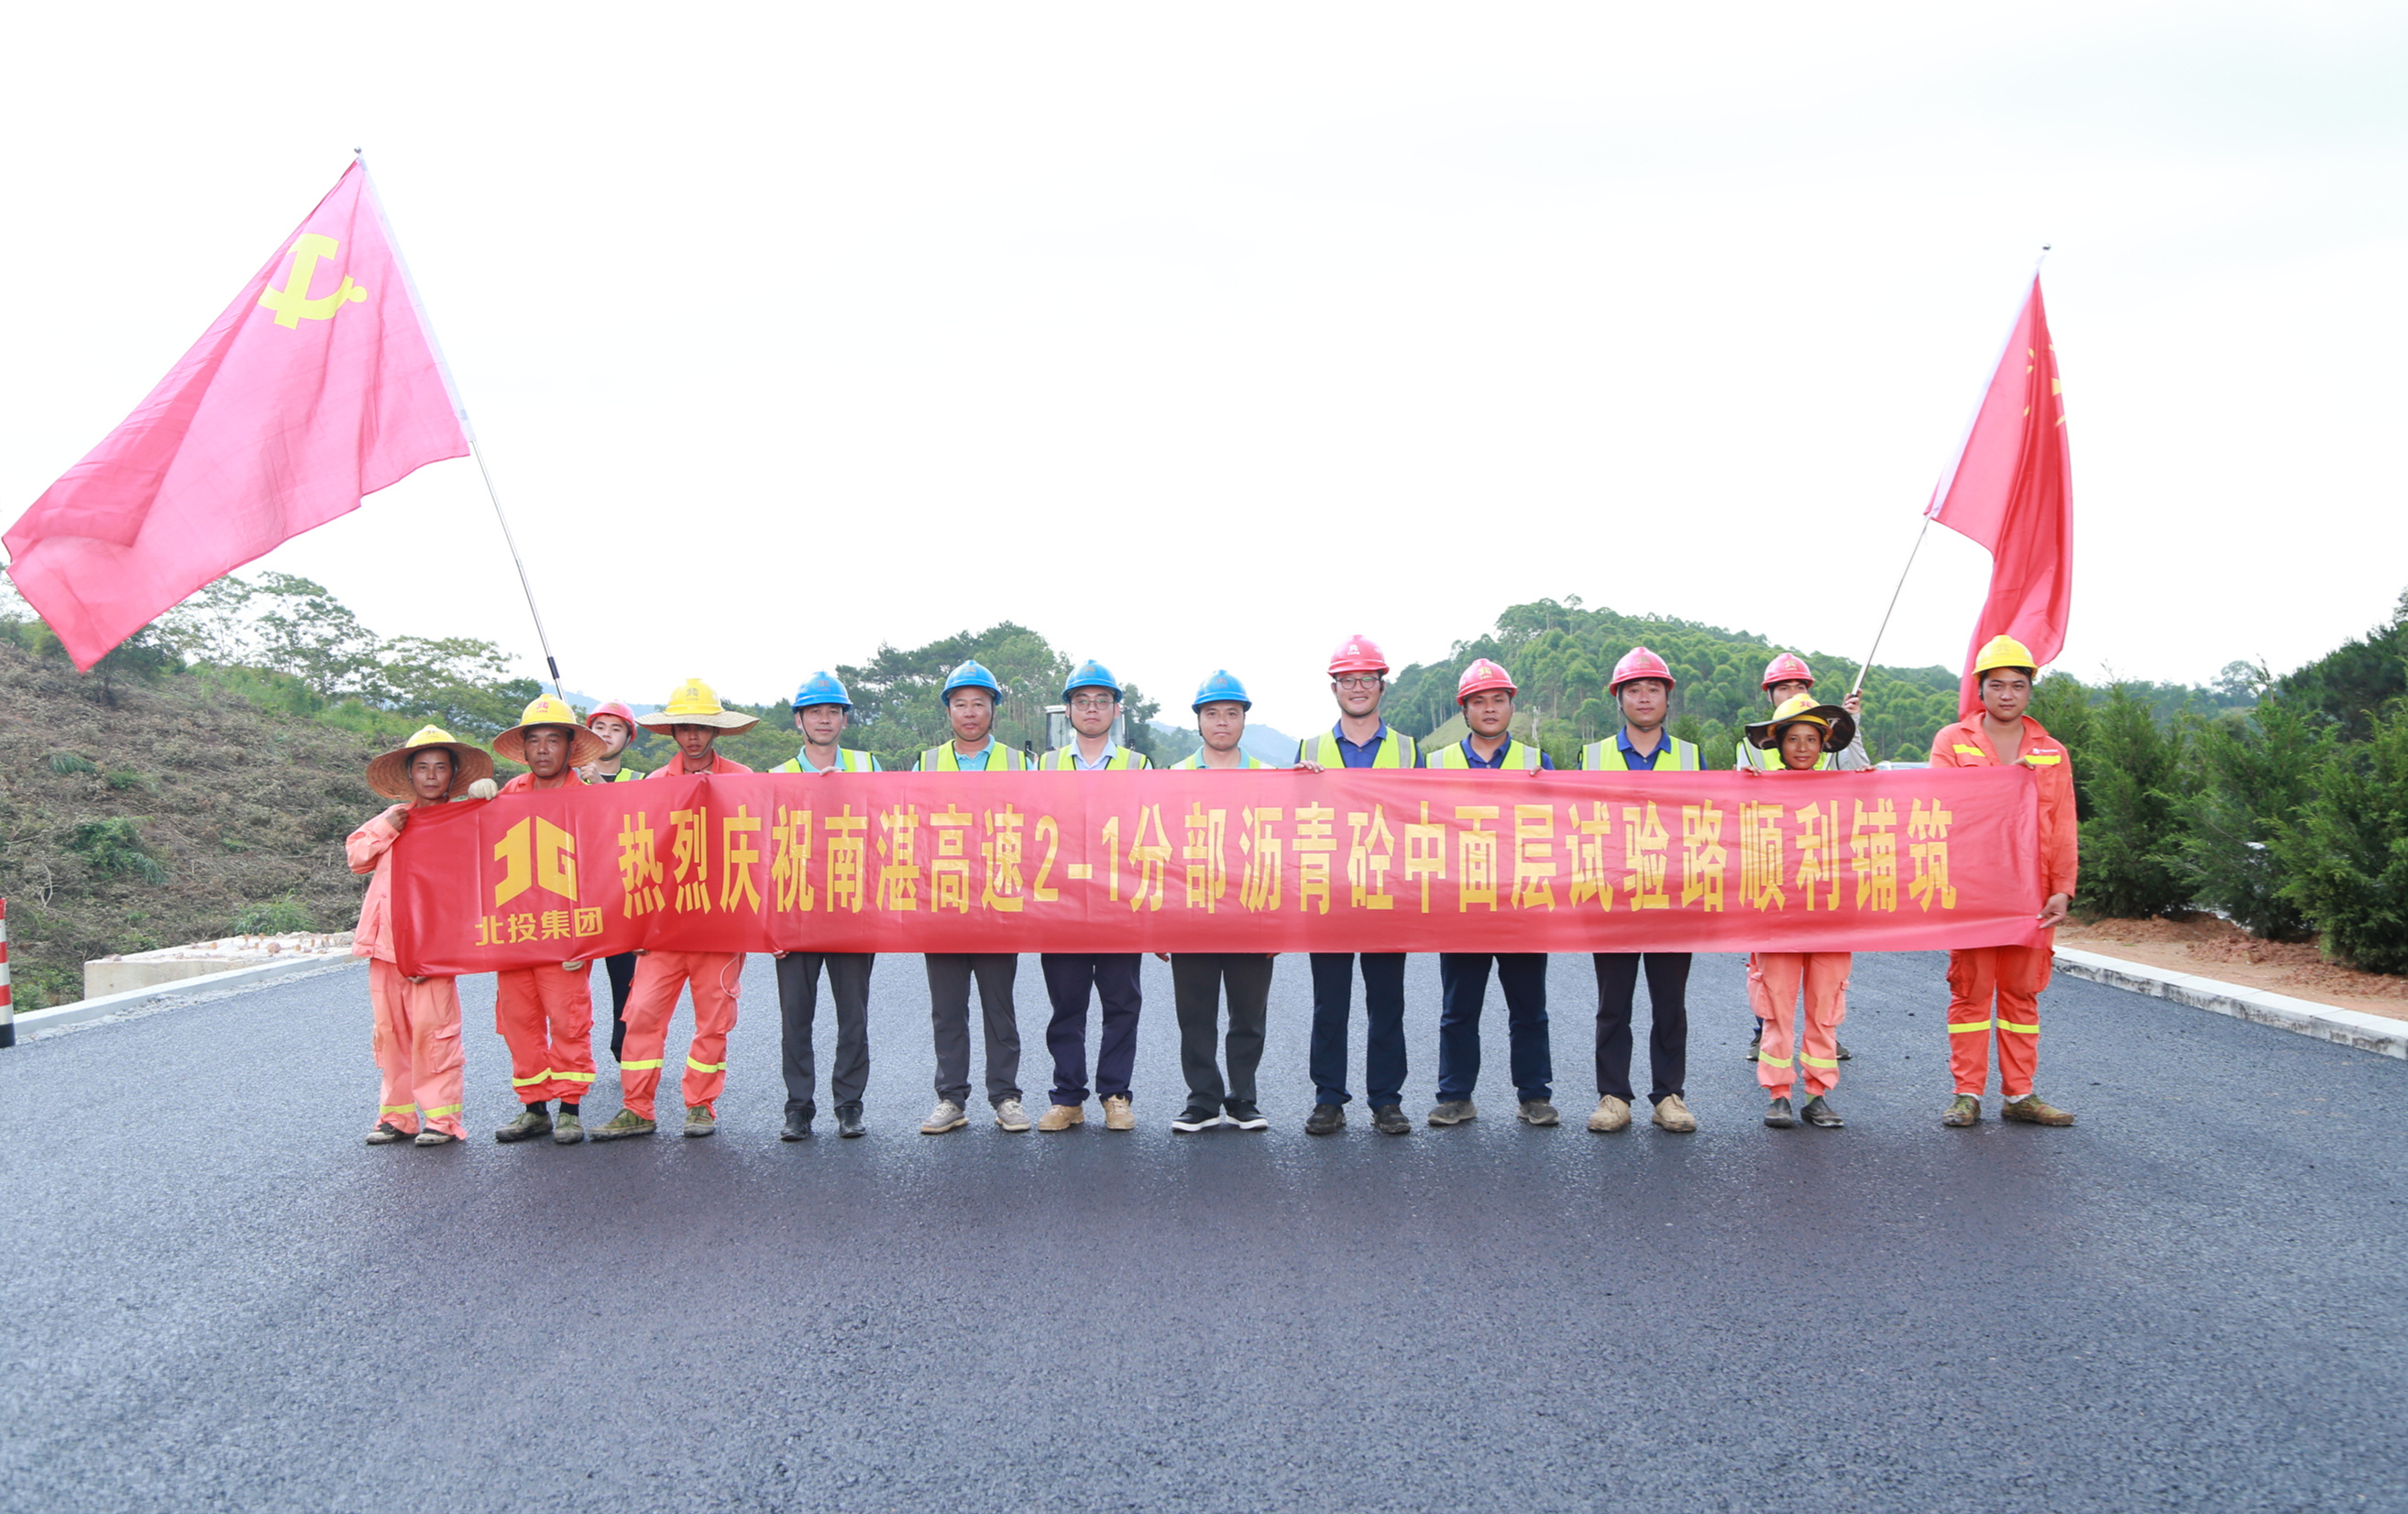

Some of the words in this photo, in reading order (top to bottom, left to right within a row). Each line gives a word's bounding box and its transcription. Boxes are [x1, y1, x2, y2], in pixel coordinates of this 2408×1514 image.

[618, 797, 1957, 918] 热烈庆祝南湛高速2-1分部沥青砼中面层试验路顺利铺筑
[475, 907, 603, 946] 北投集团
